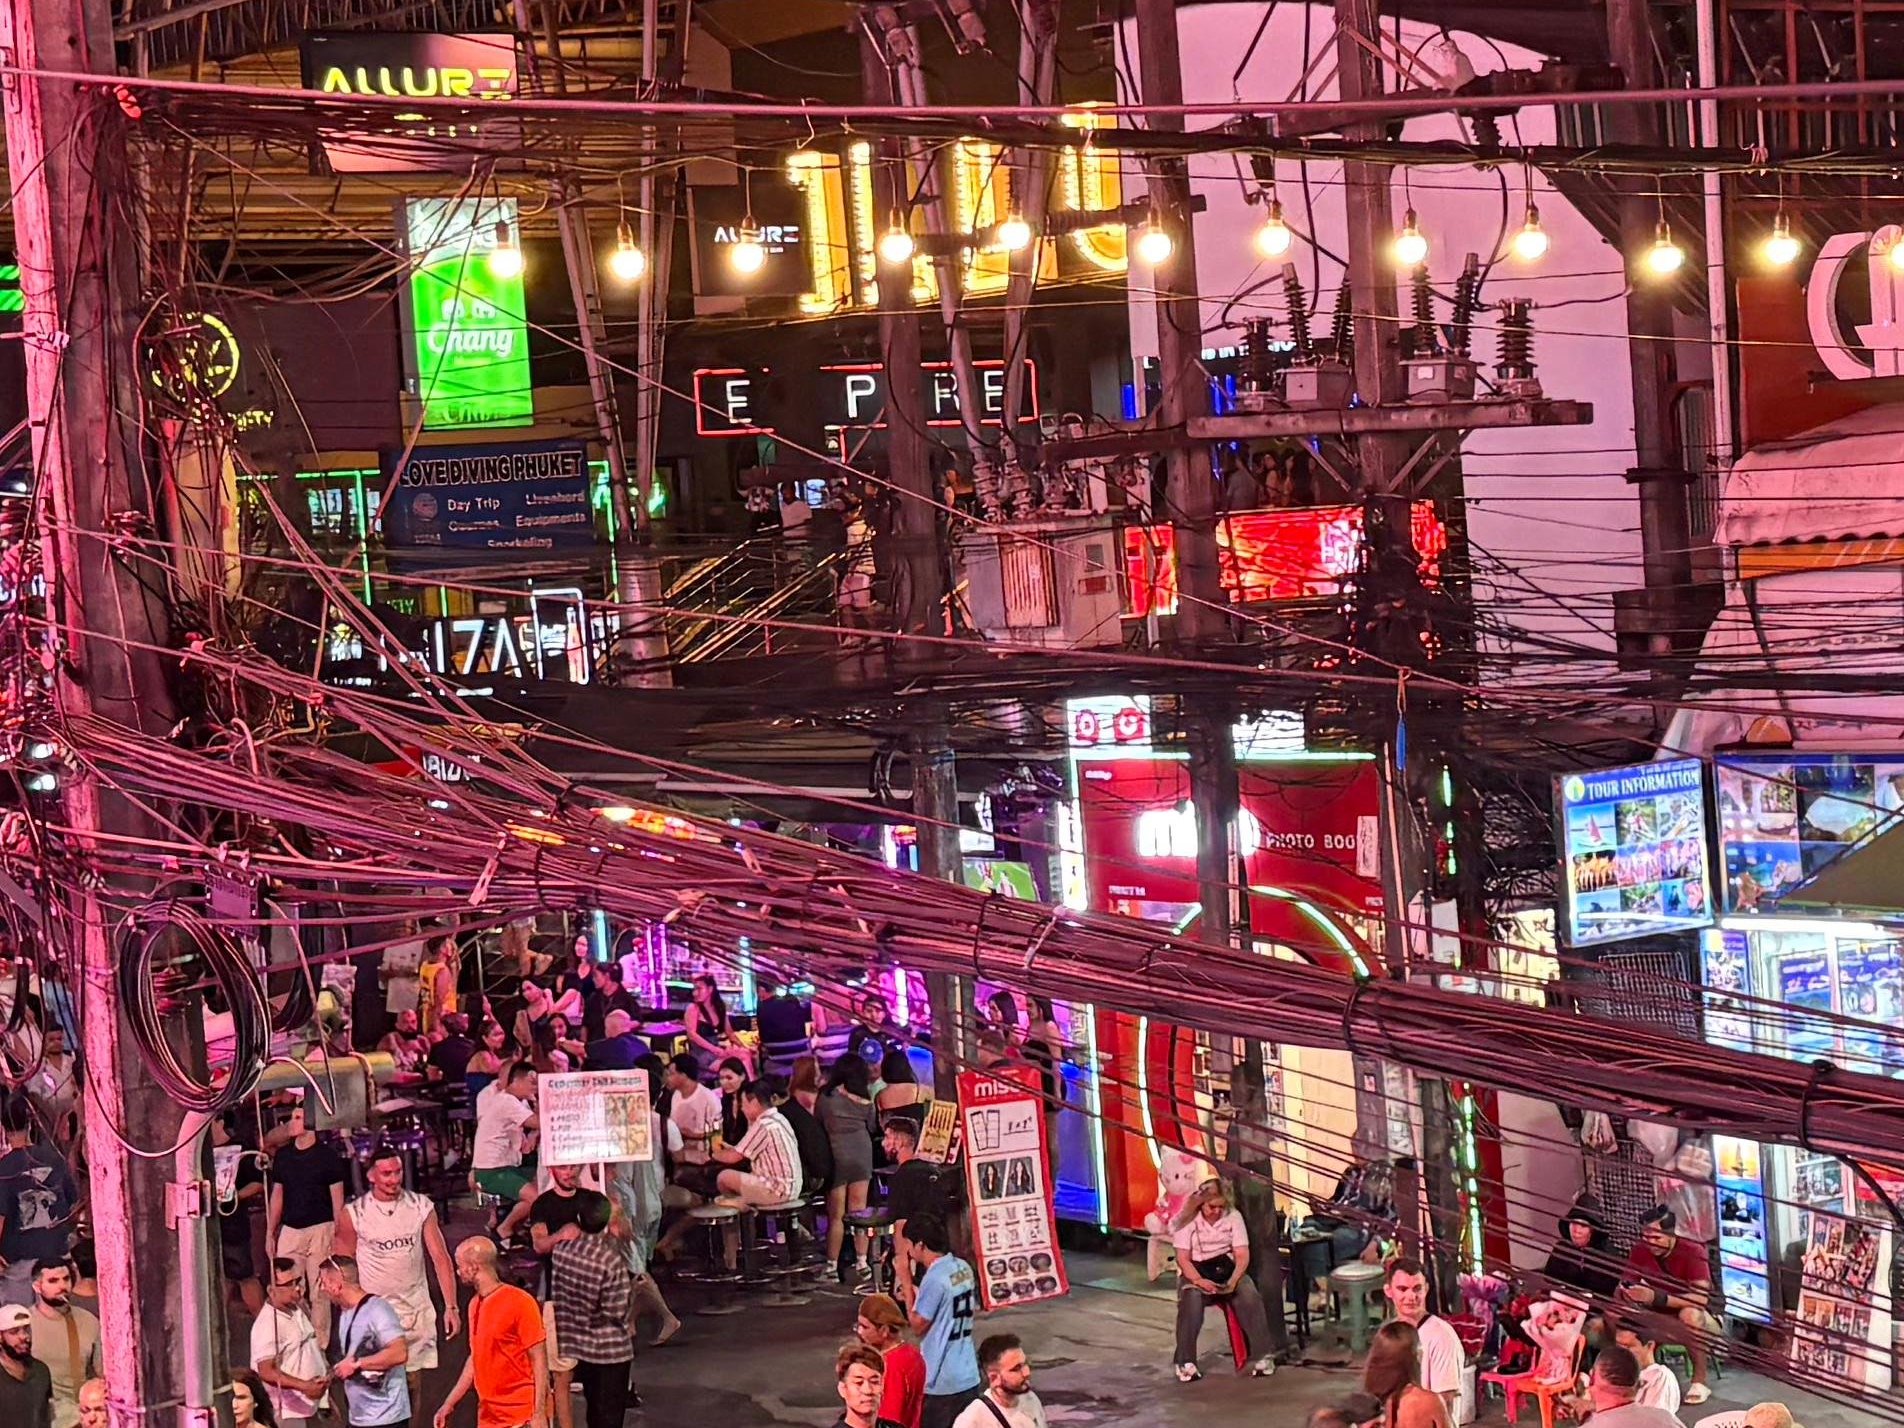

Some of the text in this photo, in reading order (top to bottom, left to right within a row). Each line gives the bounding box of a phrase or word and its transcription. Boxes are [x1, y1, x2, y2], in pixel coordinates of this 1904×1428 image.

[714, 226, 799, 243] ALURE
[427, 321, 515, 358] Chang
[449, 454, 511, 486] DIVING
[513, 451, 583, 481] PHUKET
[1587, 771, 1700, 800] TOUR INFORMATION
[1265, 832, 1356, 849] PHOTO BOO
